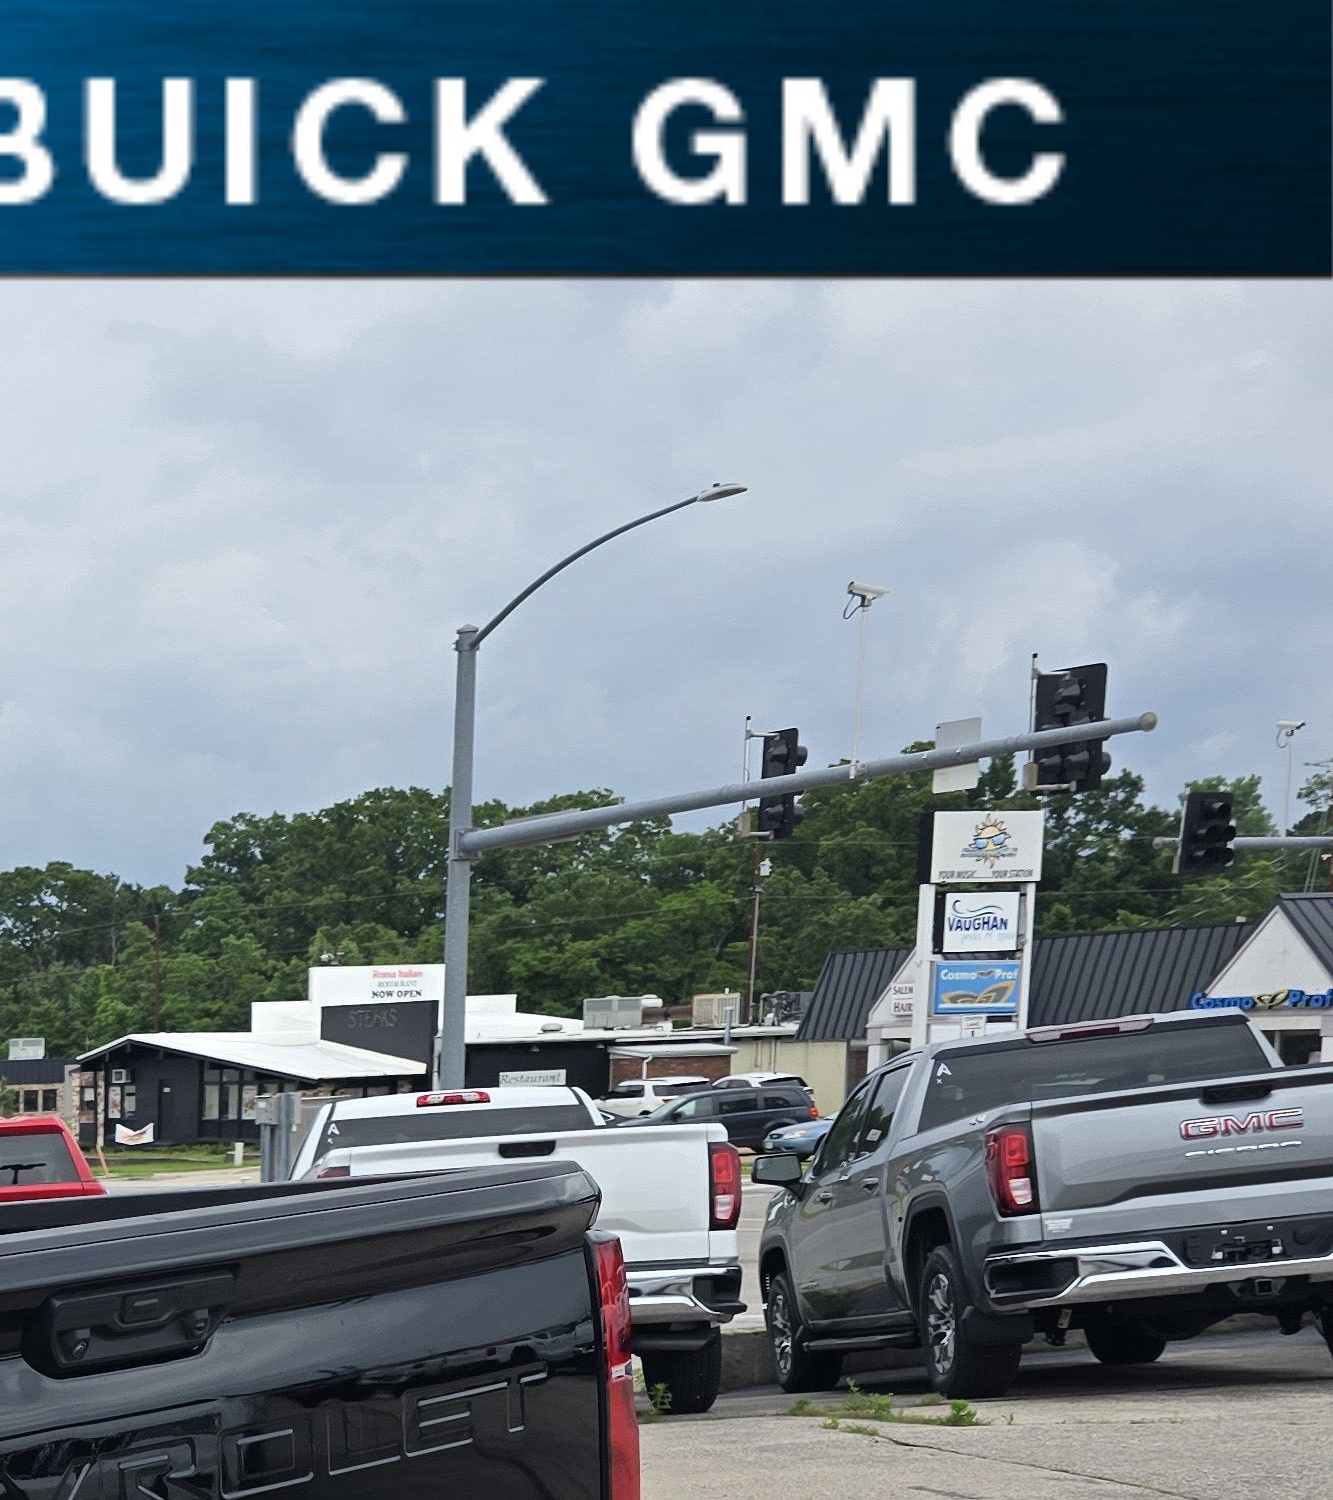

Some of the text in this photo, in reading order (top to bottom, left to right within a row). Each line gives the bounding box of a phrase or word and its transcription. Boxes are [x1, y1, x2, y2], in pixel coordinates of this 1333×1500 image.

[947, 915, 1008, 931] VAUGHAN
[940, 967, 1019, 981] Cosmo Prof
[371, 990, 423, 999] NOW OPEN
[1191, 988, 1333, 1010] Cosmo Prof
[501, 1073, 561, 1084] Restaurant
[1179, 1107, 1304, 1140] GMC
